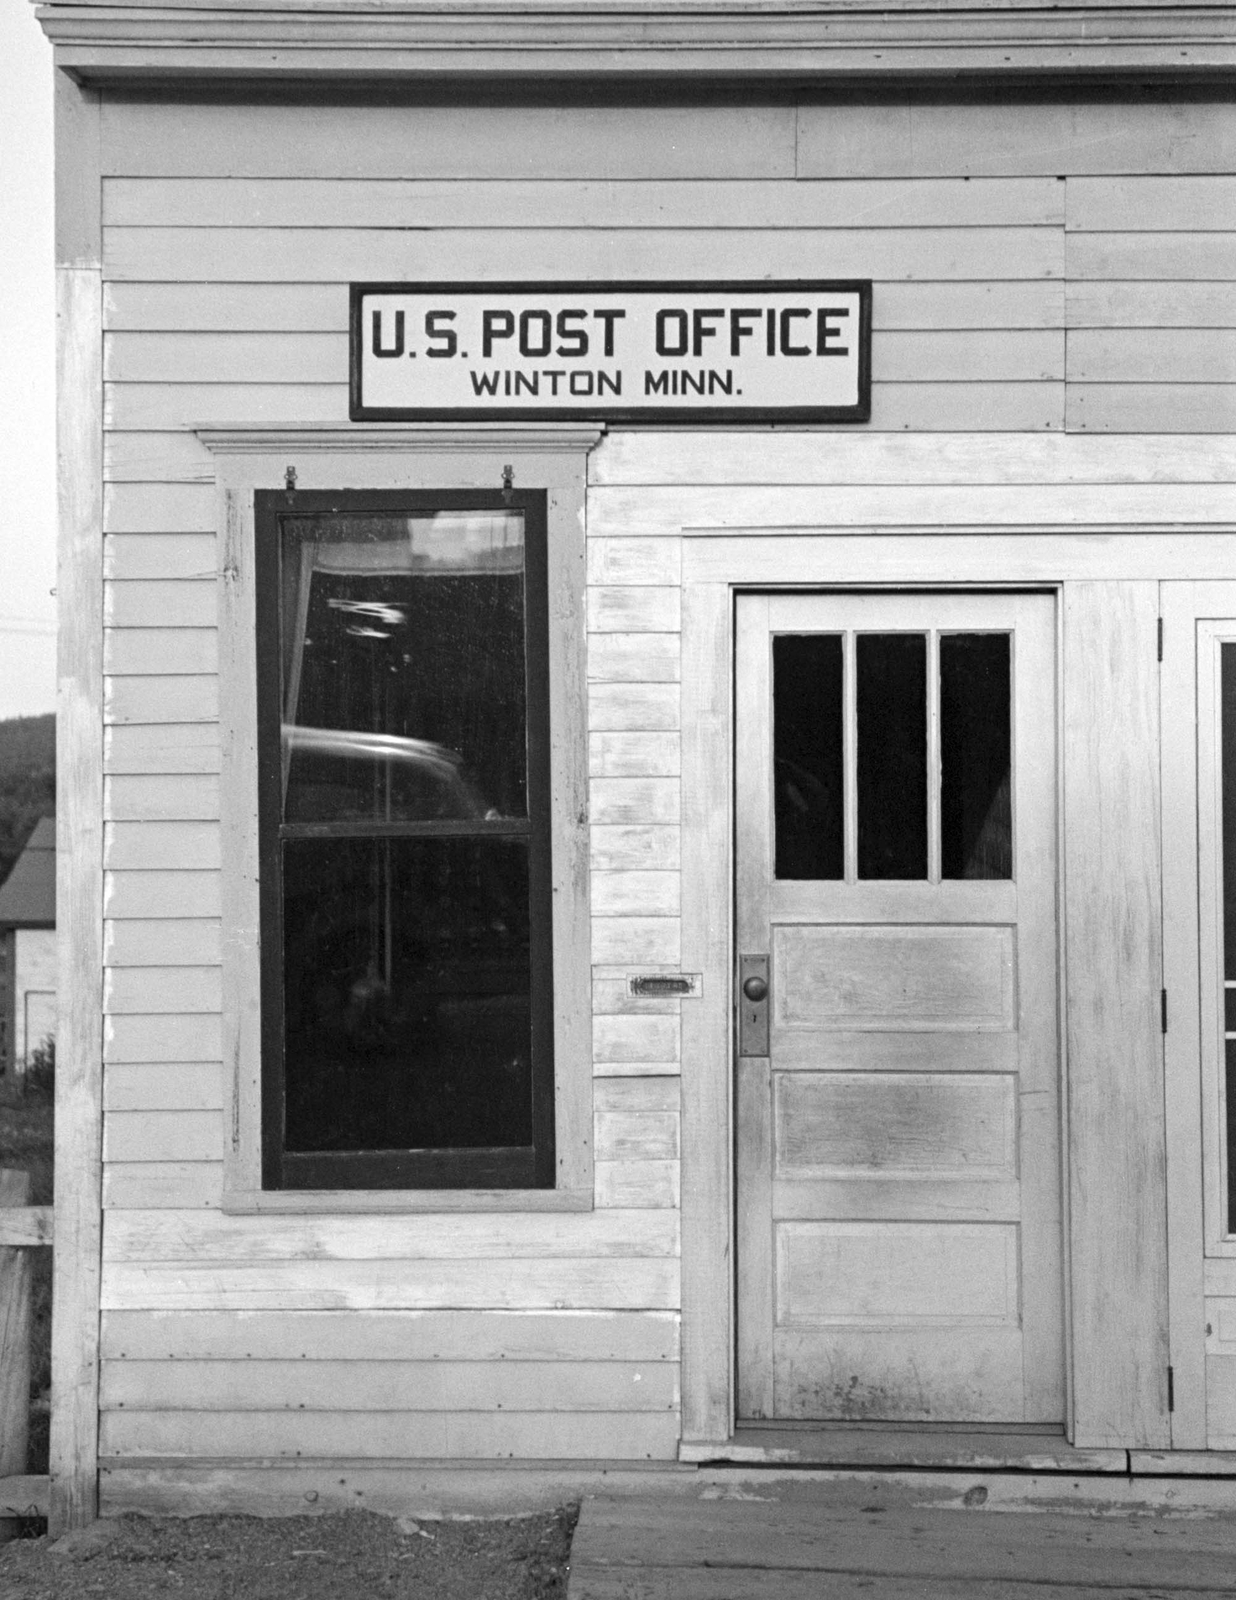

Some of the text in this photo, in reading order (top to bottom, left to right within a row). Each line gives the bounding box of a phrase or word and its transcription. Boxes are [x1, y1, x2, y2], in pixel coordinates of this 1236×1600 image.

[372, 307, 850, 358] U.S. POST OFFICE
[470, 369, 743, 396] WINTON MINN.
